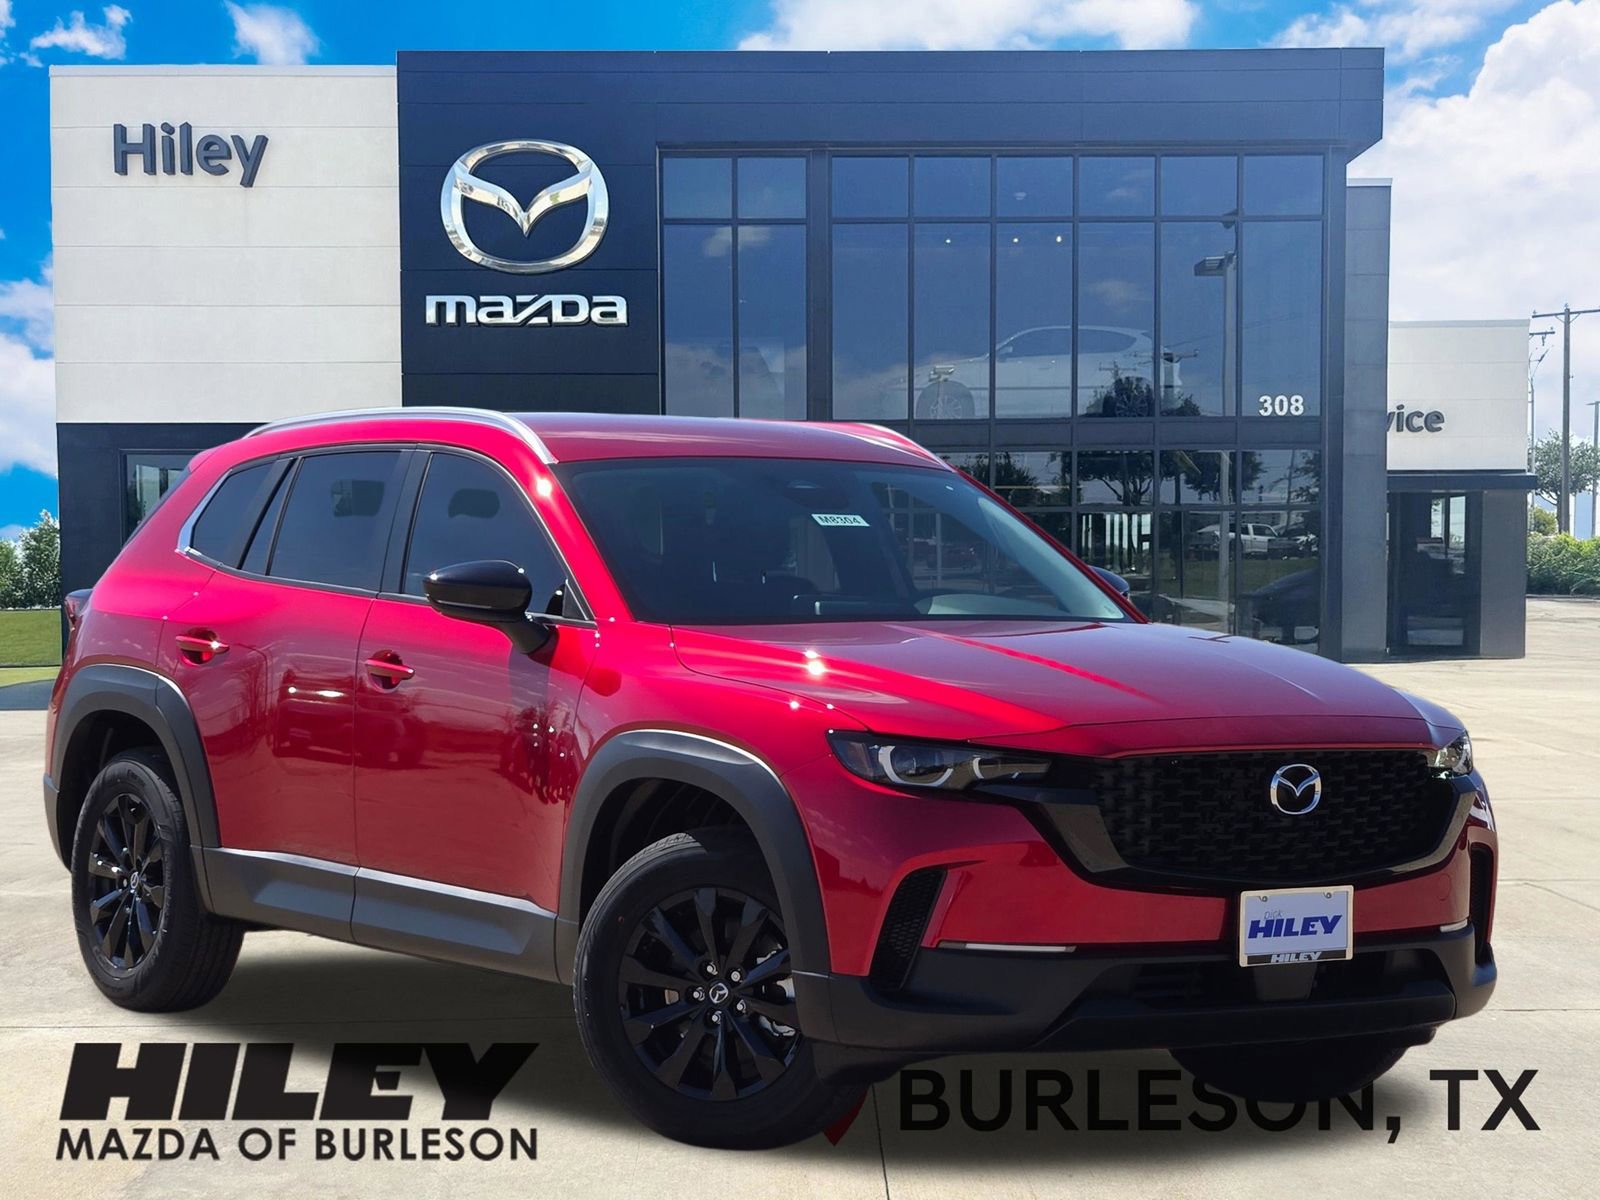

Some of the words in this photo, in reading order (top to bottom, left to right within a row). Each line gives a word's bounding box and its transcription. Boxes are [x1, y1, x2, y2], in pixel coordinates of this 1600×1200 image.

[113, 122, 268, 187] Hiley
[1258, 394, 1304, 416] 308
[1248, 915, 1342, 939] HILEY
[1270, 951, 1322, 964] HILEY
